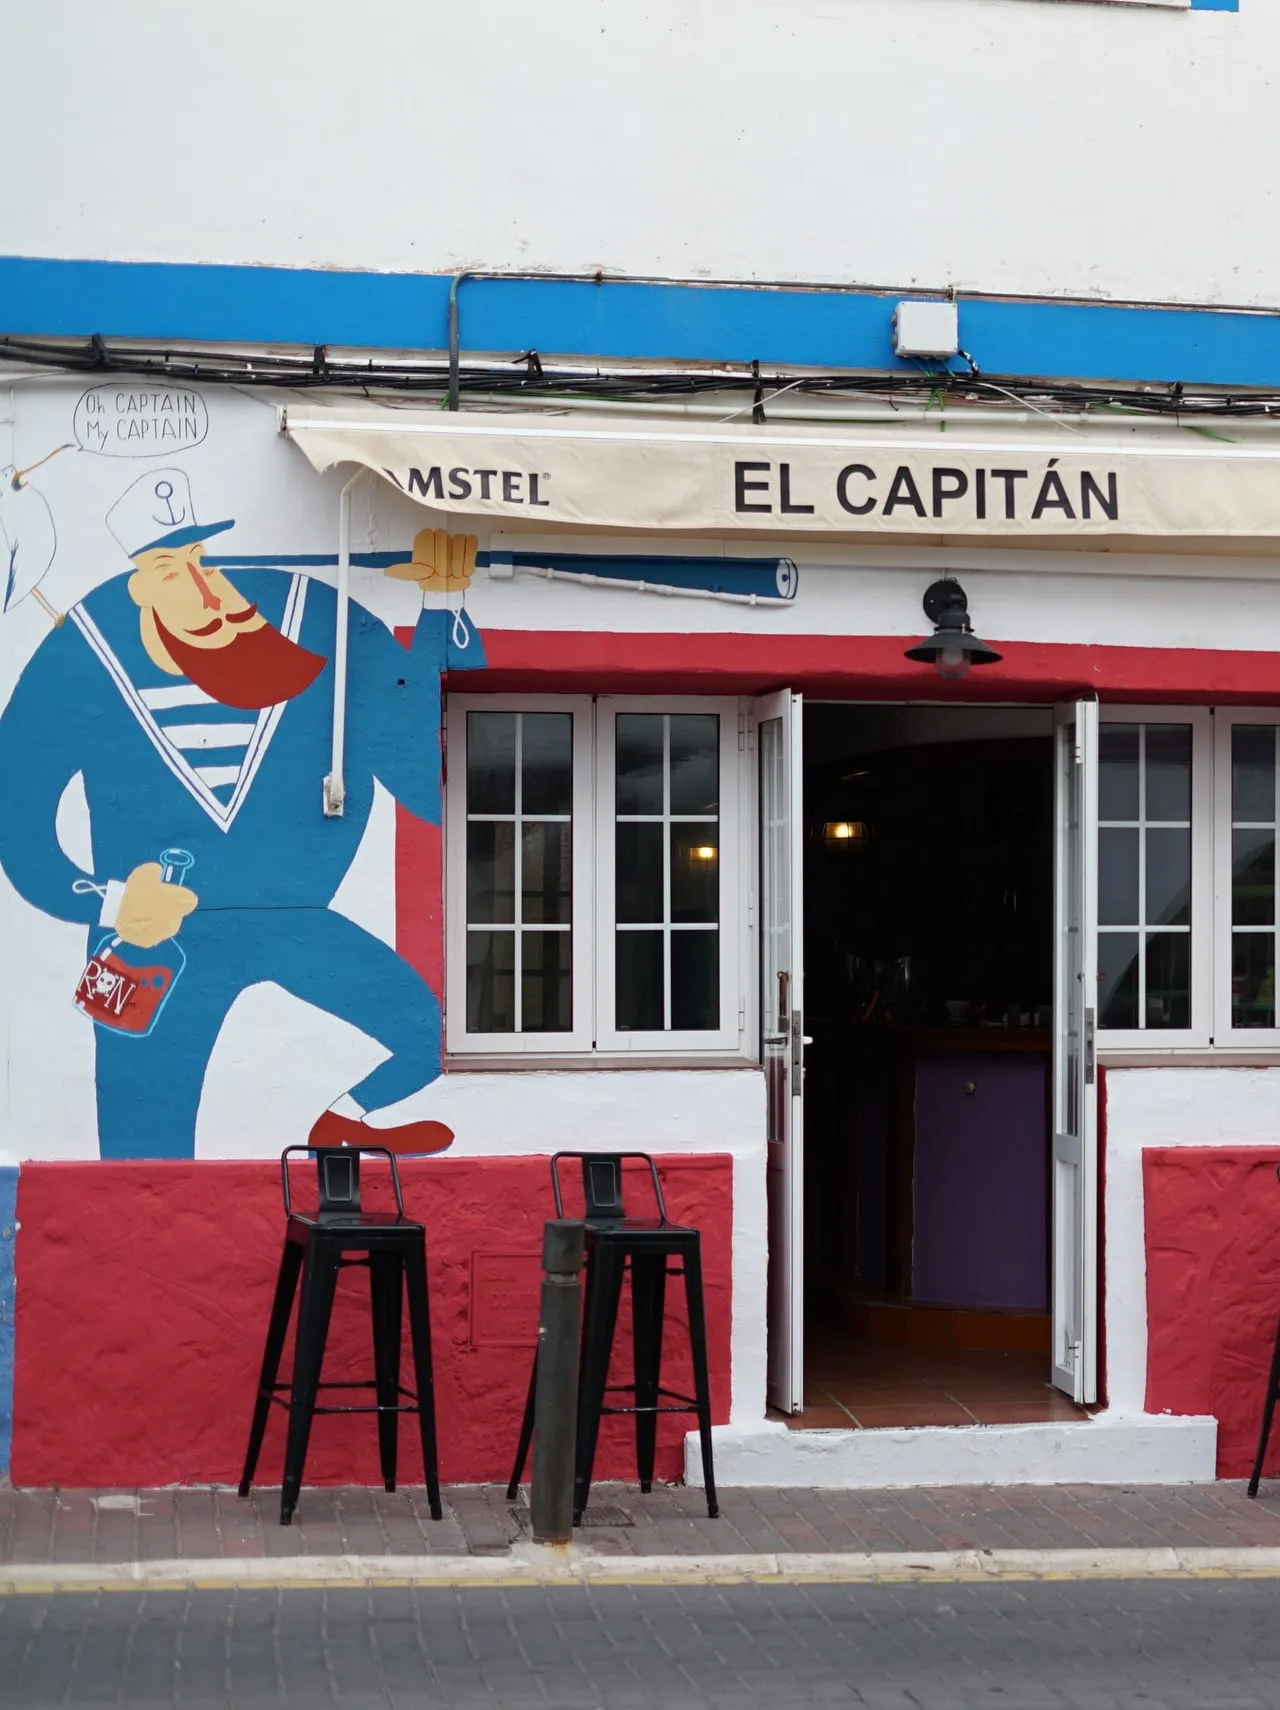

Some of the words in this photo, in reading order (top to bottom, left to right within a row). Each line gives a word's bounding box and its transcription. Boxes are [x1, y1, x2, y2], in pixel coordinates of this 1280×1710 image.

[86, 420, 109, 451] My
[116, 417, 197, 441] CAPTAIN
[734, 461, 815, 514] EL
[836, 458, 1119, 521] CAPITÁN
